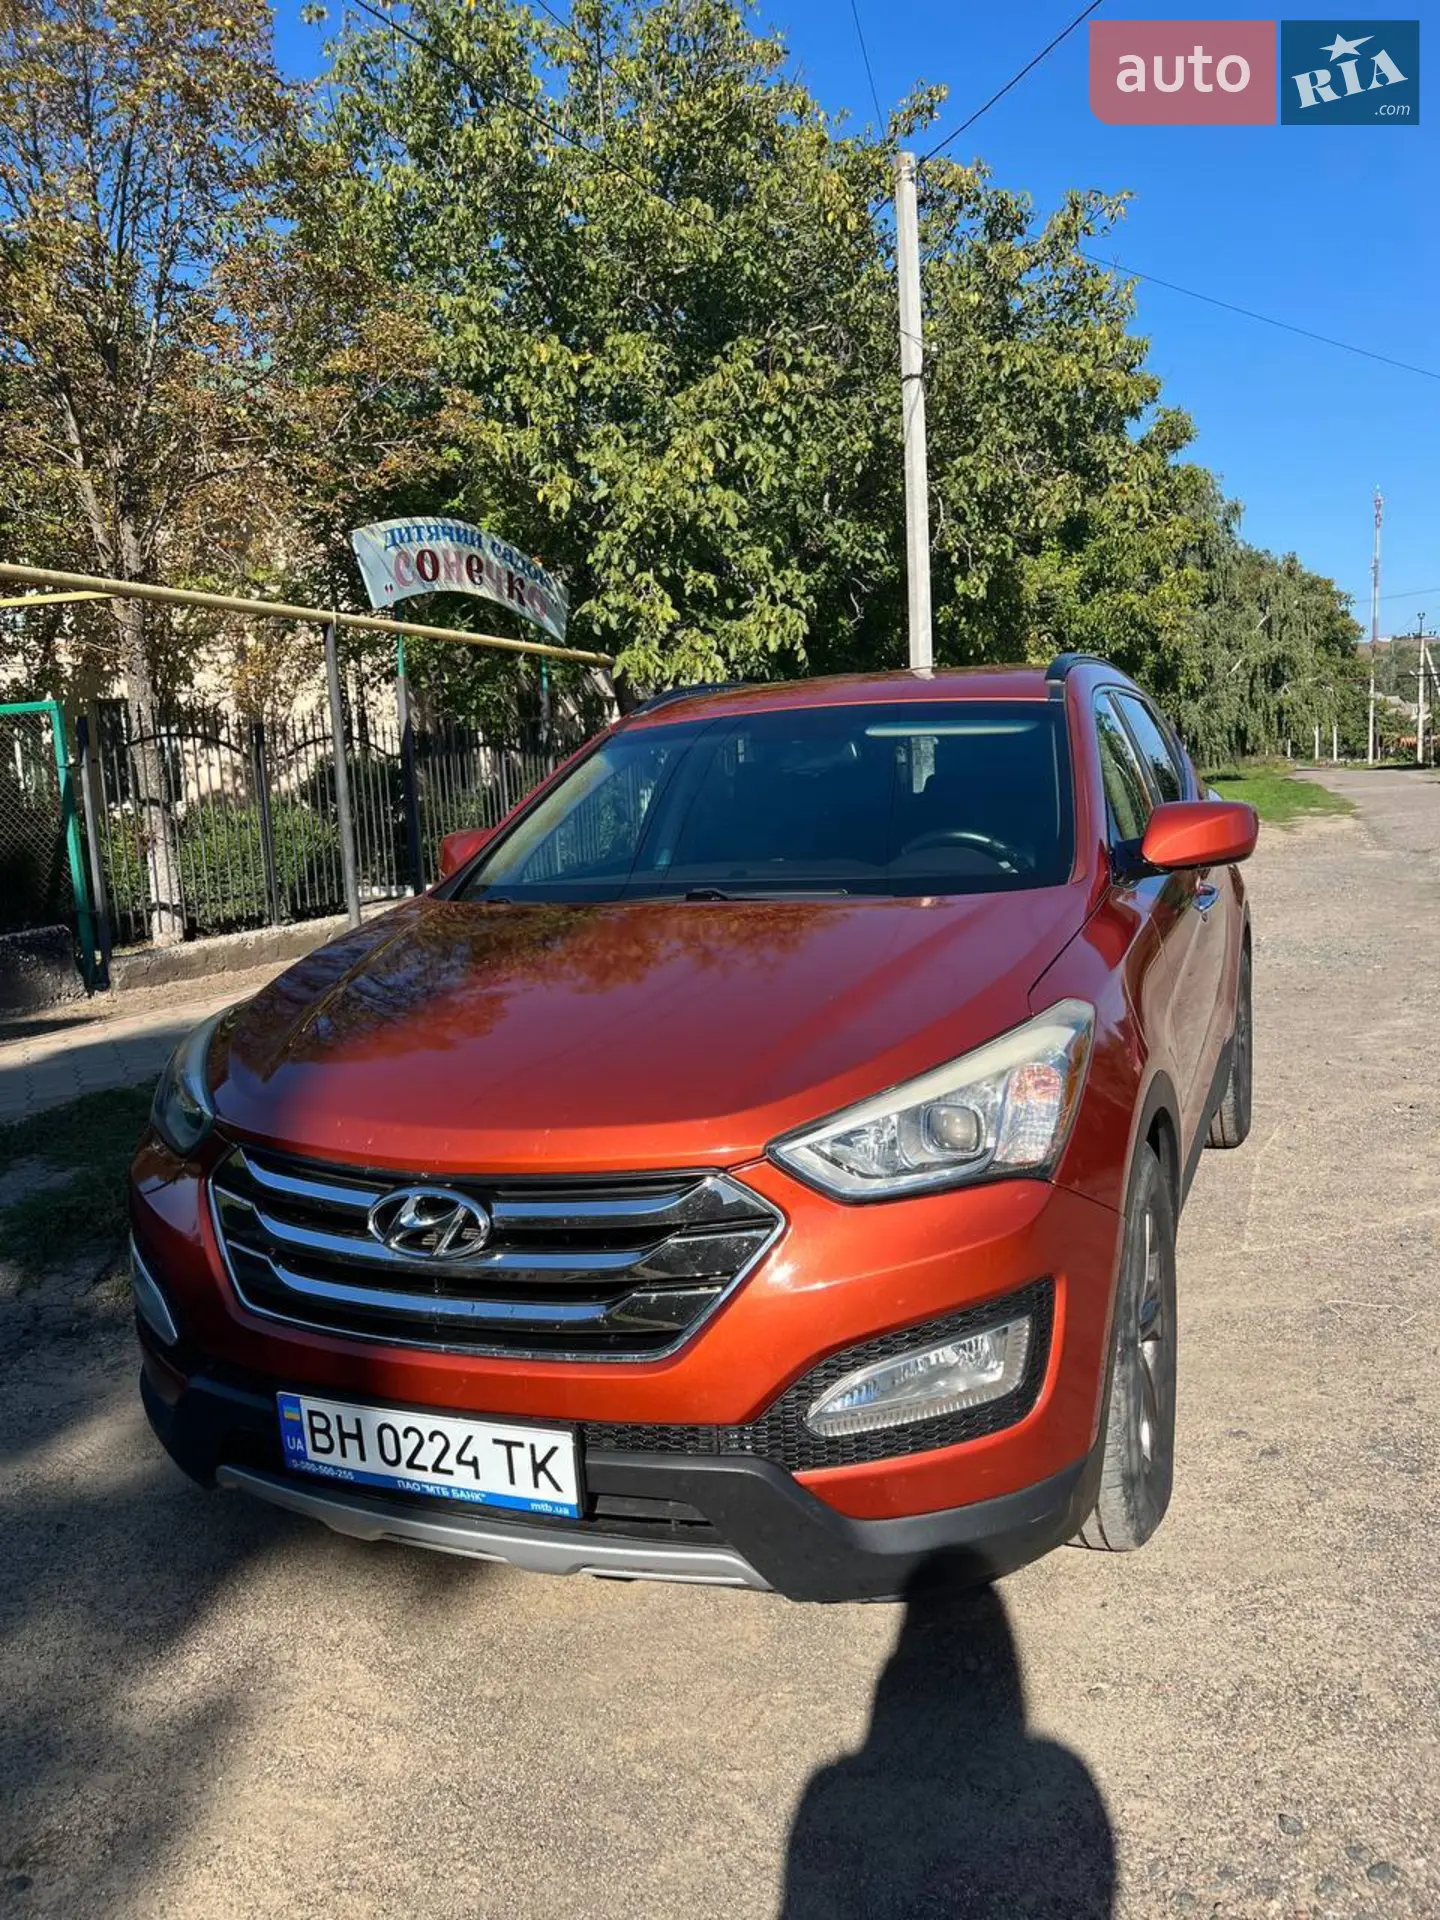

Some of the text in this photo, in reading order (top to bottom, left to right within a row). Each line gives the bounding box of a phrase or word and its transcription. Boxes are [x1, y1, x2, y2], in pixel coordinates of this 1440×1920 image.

[286, 1435, 305, 1452] UA
[307, 1409, 564, 1493] BH 0224 TK
[397, 1479, 421, 1492] ПАО
[530, 1501, 570, 1516] mtb.ua
